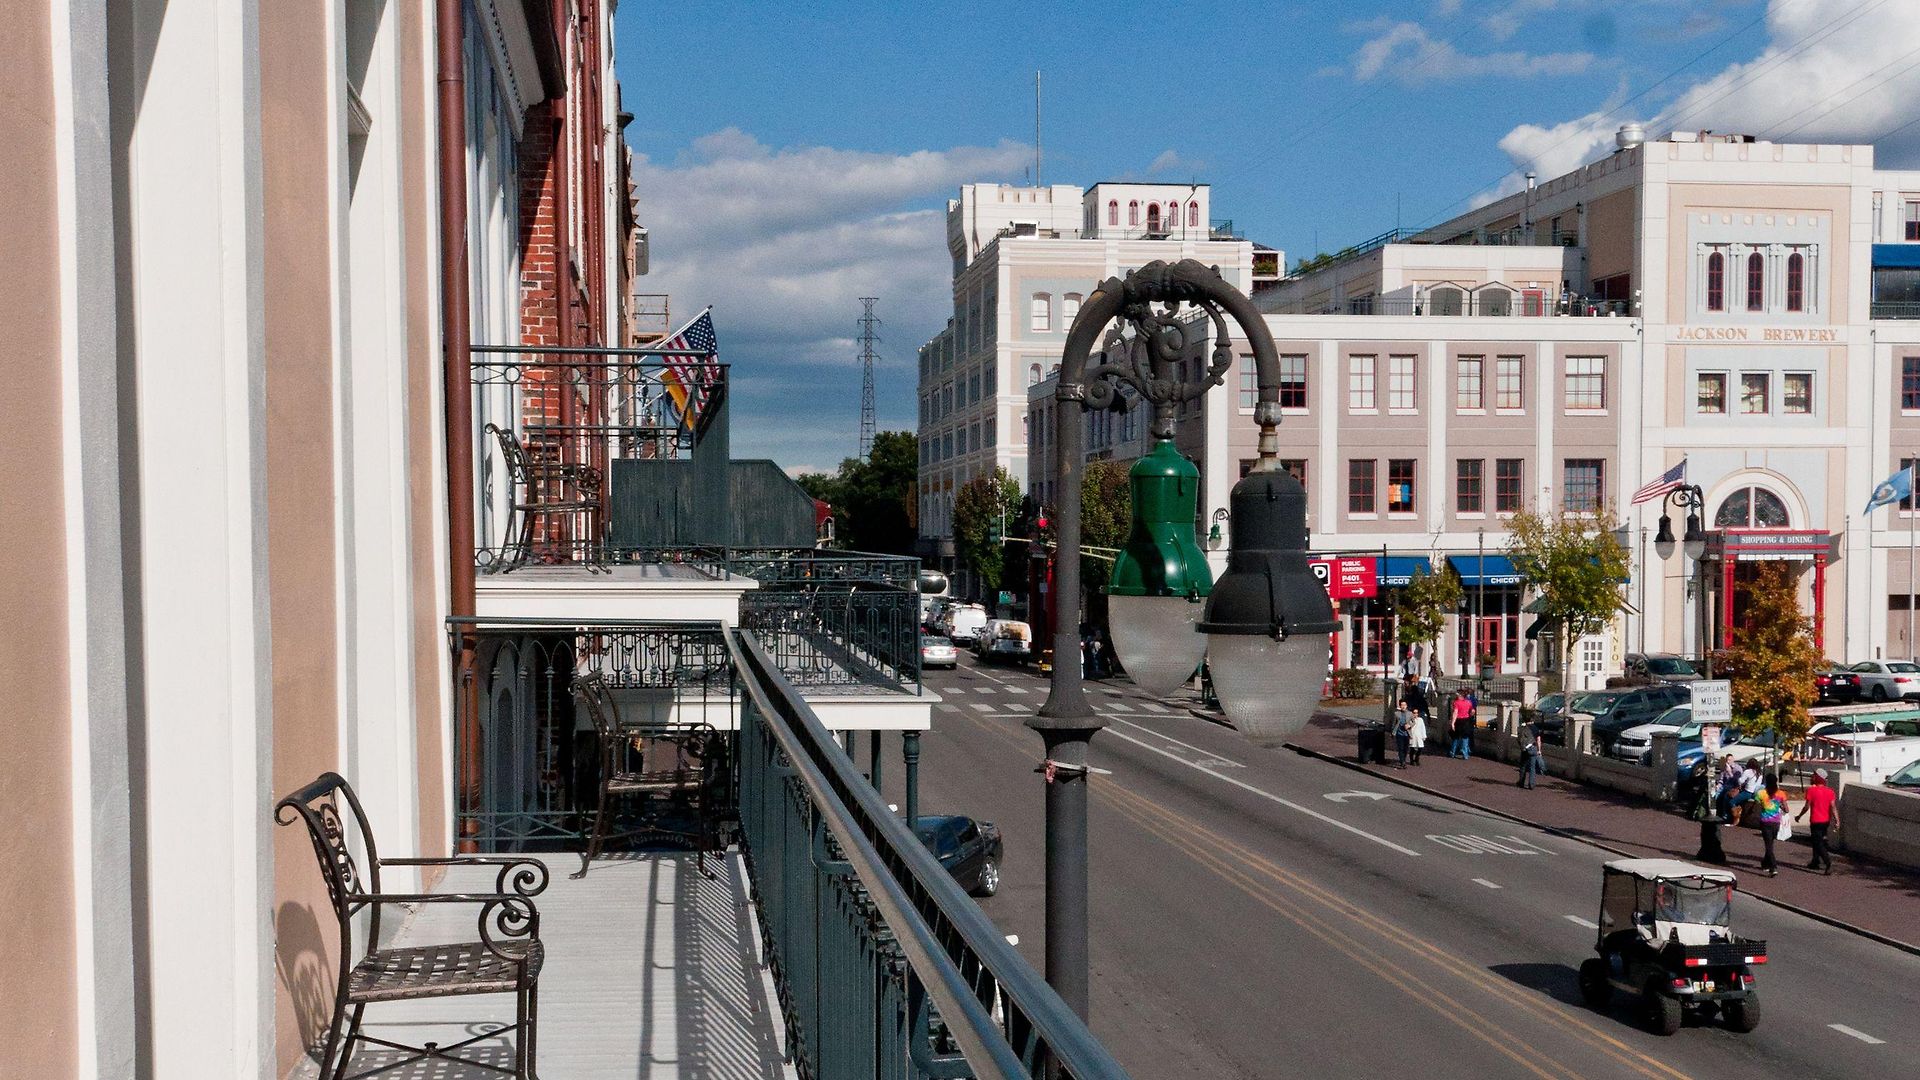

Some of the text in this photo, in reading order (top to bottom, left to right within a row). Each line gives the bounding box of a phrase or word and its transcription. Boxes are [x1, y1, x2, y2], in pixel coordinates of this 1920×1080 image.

[1676, 327, 1838, 341] JACKSON BREWERY
[1741, 535, 1813, 544] SHOPPING & DINING
[1701, 697, 1722, 705] MUST
[1424, 834, 1559, 856] ONLY
